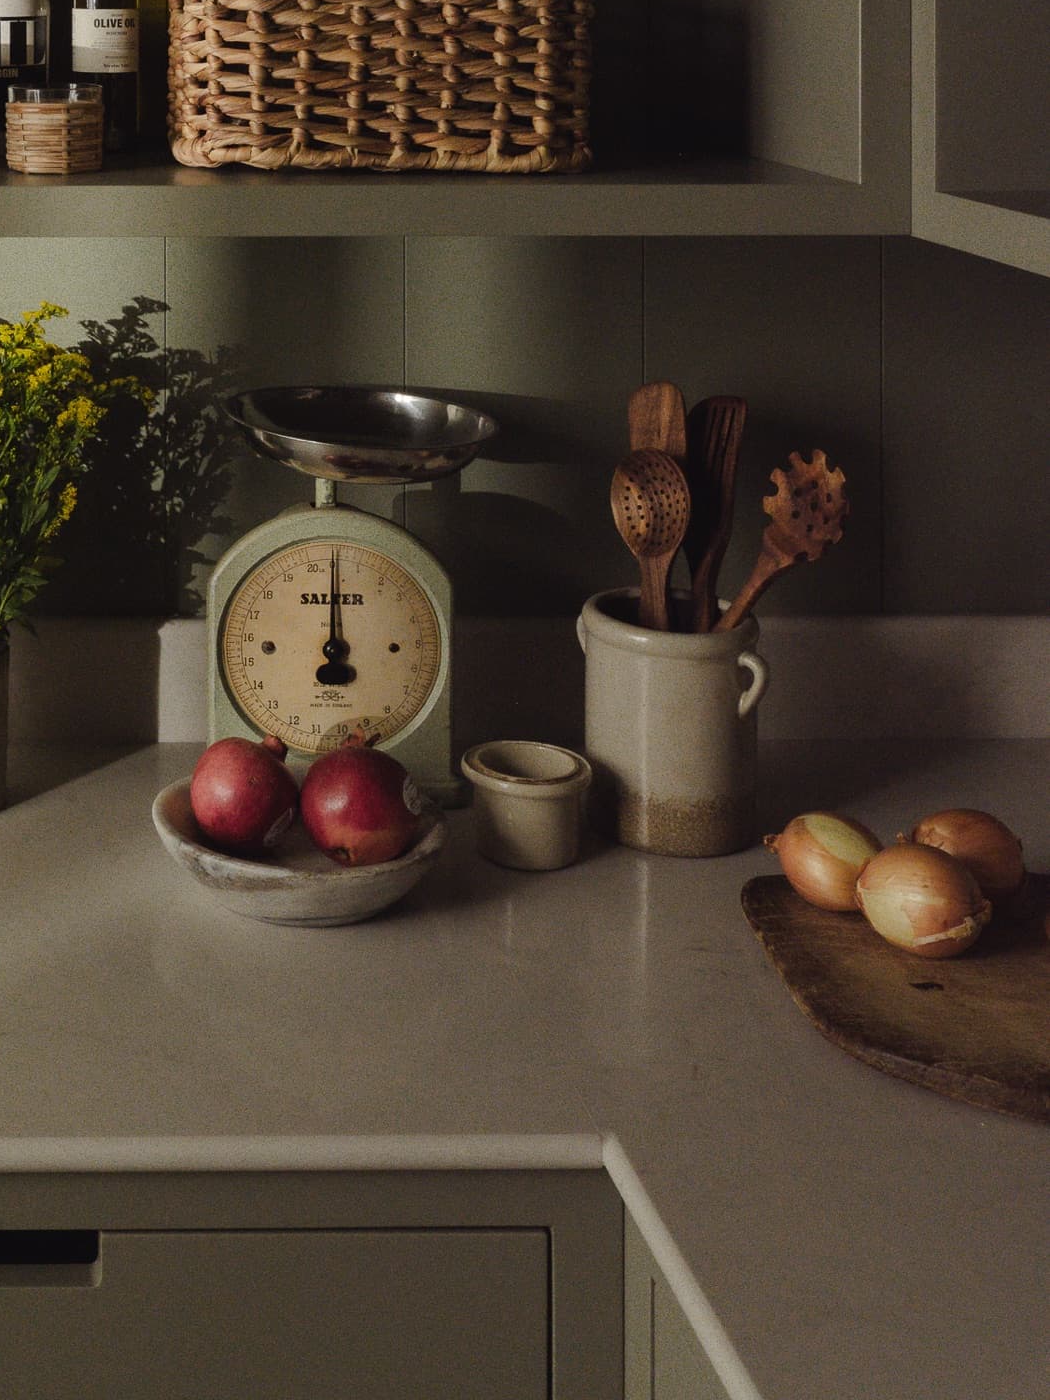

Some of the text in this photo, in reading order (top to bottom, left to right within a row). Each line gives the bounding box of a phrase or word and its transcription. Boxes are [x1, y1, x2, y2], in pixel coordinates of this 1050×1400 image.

[94, 18, 123, 28] OLIVE
[307, 563, 319, 573] 20
[283, 573, 294, 582] 19
[378, 576, 384, 586] 2
[263, 590, 273, 600] 18
[300, 593, 364, 606] SALTER
[396, 592, 402, 602] 3
[249, 610, 260, 620] 17
[409, 615, 416, 624] 4
[243, 633, 255, 642] 16
[244, 657, 255, 667] 15
[253, 680, 264, 690] 14
[402, 685, 409, 695] 7
[268, 700, 279, 710] 13
[384, 705, 391, 714] 8
[289, 715, 300, 725] 12
[363, 718, 370, 727] 9
[311, 724, 321, 734] 11
[337, 724, 348, 734] 10
